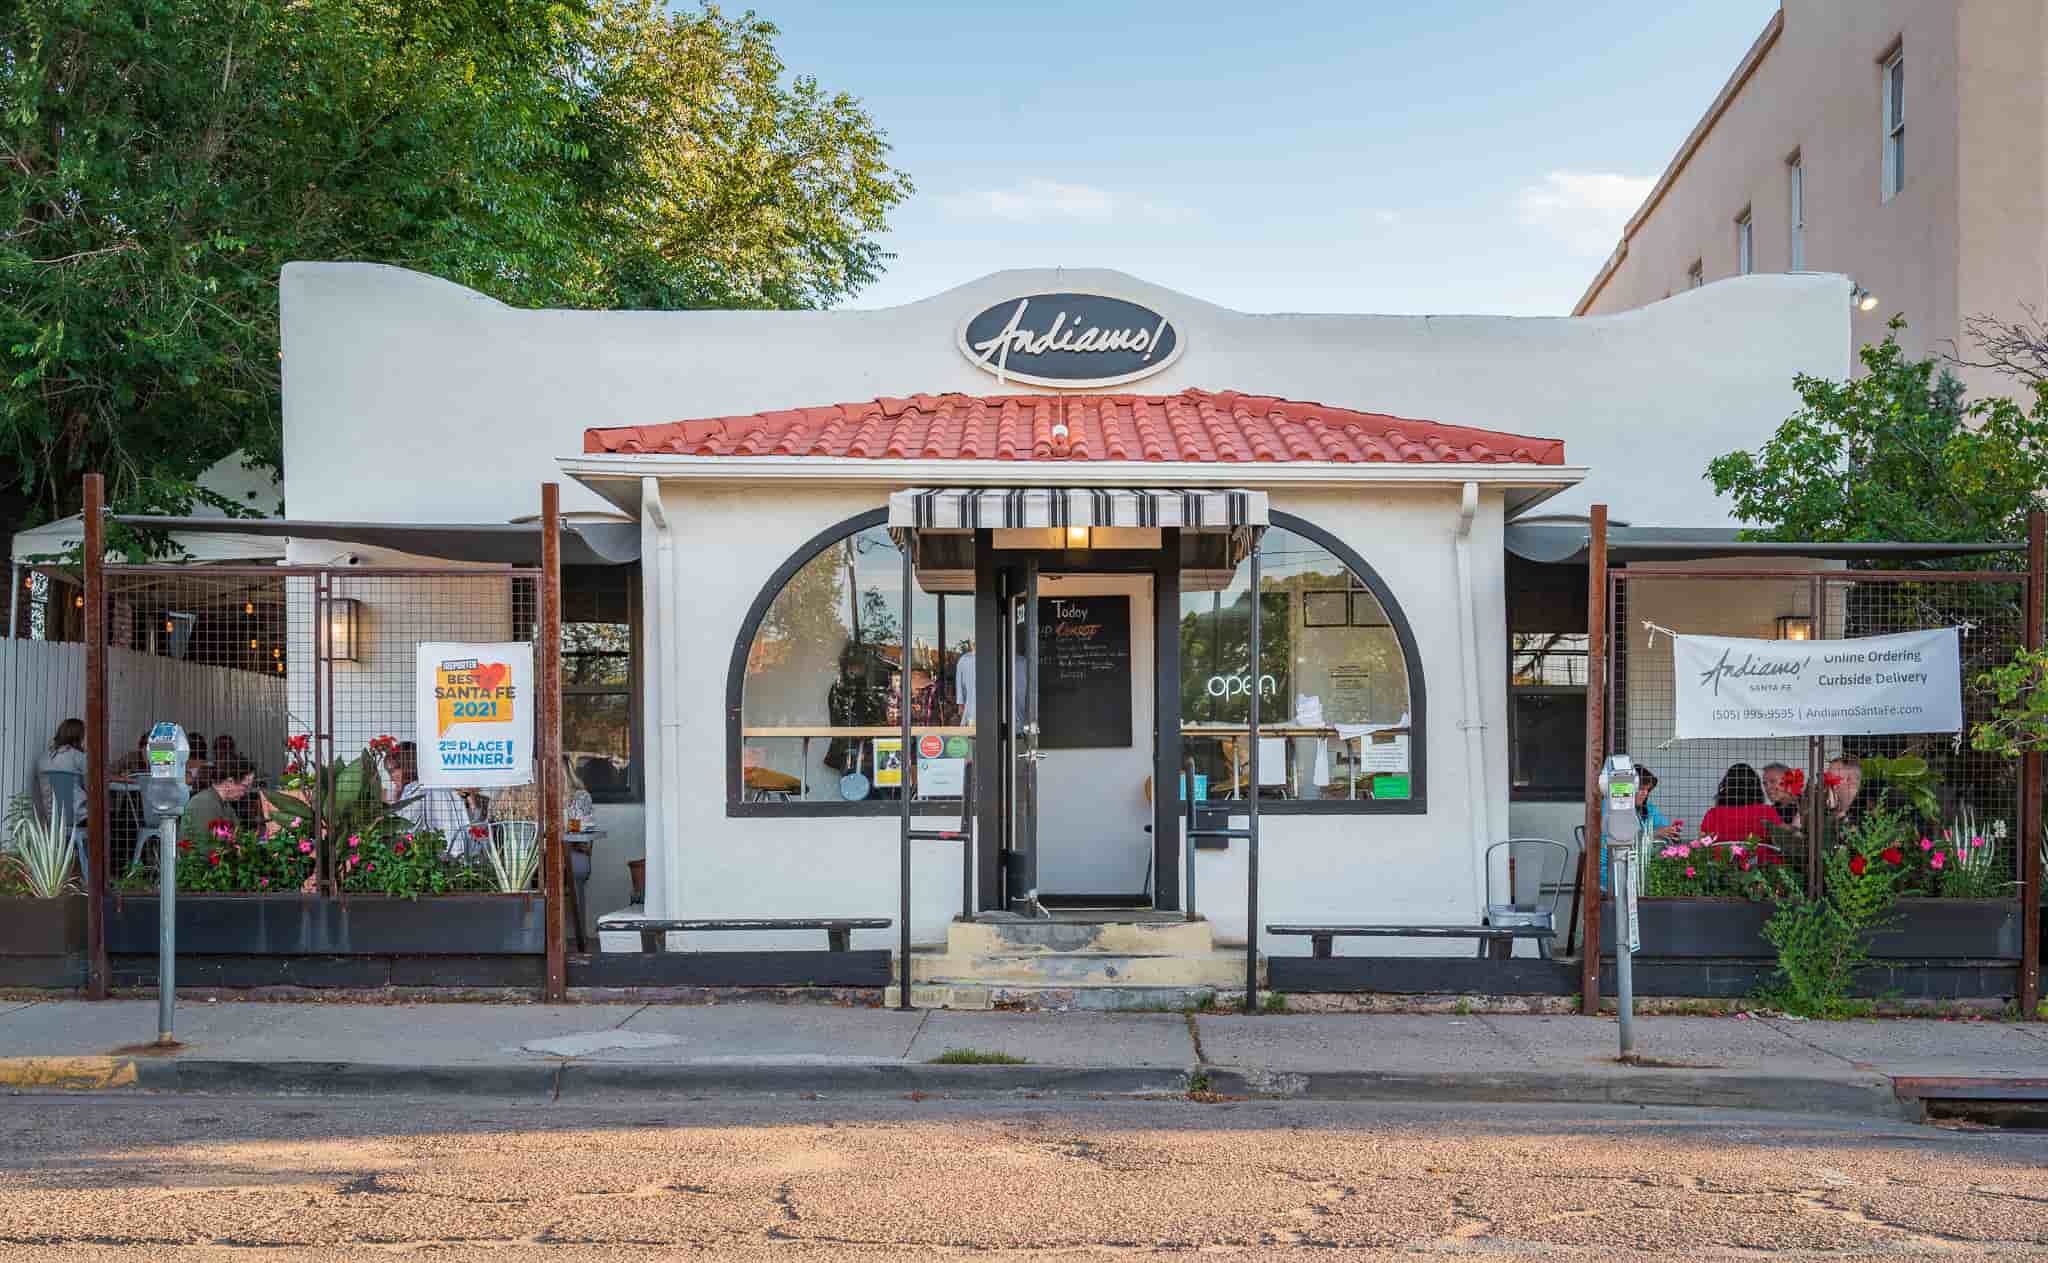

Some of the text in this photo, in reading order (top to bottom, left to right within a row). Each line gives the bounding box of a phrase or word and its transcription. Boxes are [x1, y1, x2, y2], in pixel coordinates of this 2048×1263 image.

[974, 299, 1168, 384] Andiamo!
[1051, 599, 1088, 622] Today
[1824, 649, 1922, 664] Online Ordering
[1700, 648, 1811, 696] Andiamo!
[1818, 671, 1928, 686] Curbside Delivery
[435, 686, 517, 699] SANTA FE
[1208, 675, 1276, 703] open
[1749, 683, 1792, 692] SANTA FE
[453, 701, 497, 717] 2021
[1806, 705, 1923, 719] AndiamoSantaFe.com
[459, 740, 504, 751] PLACE
